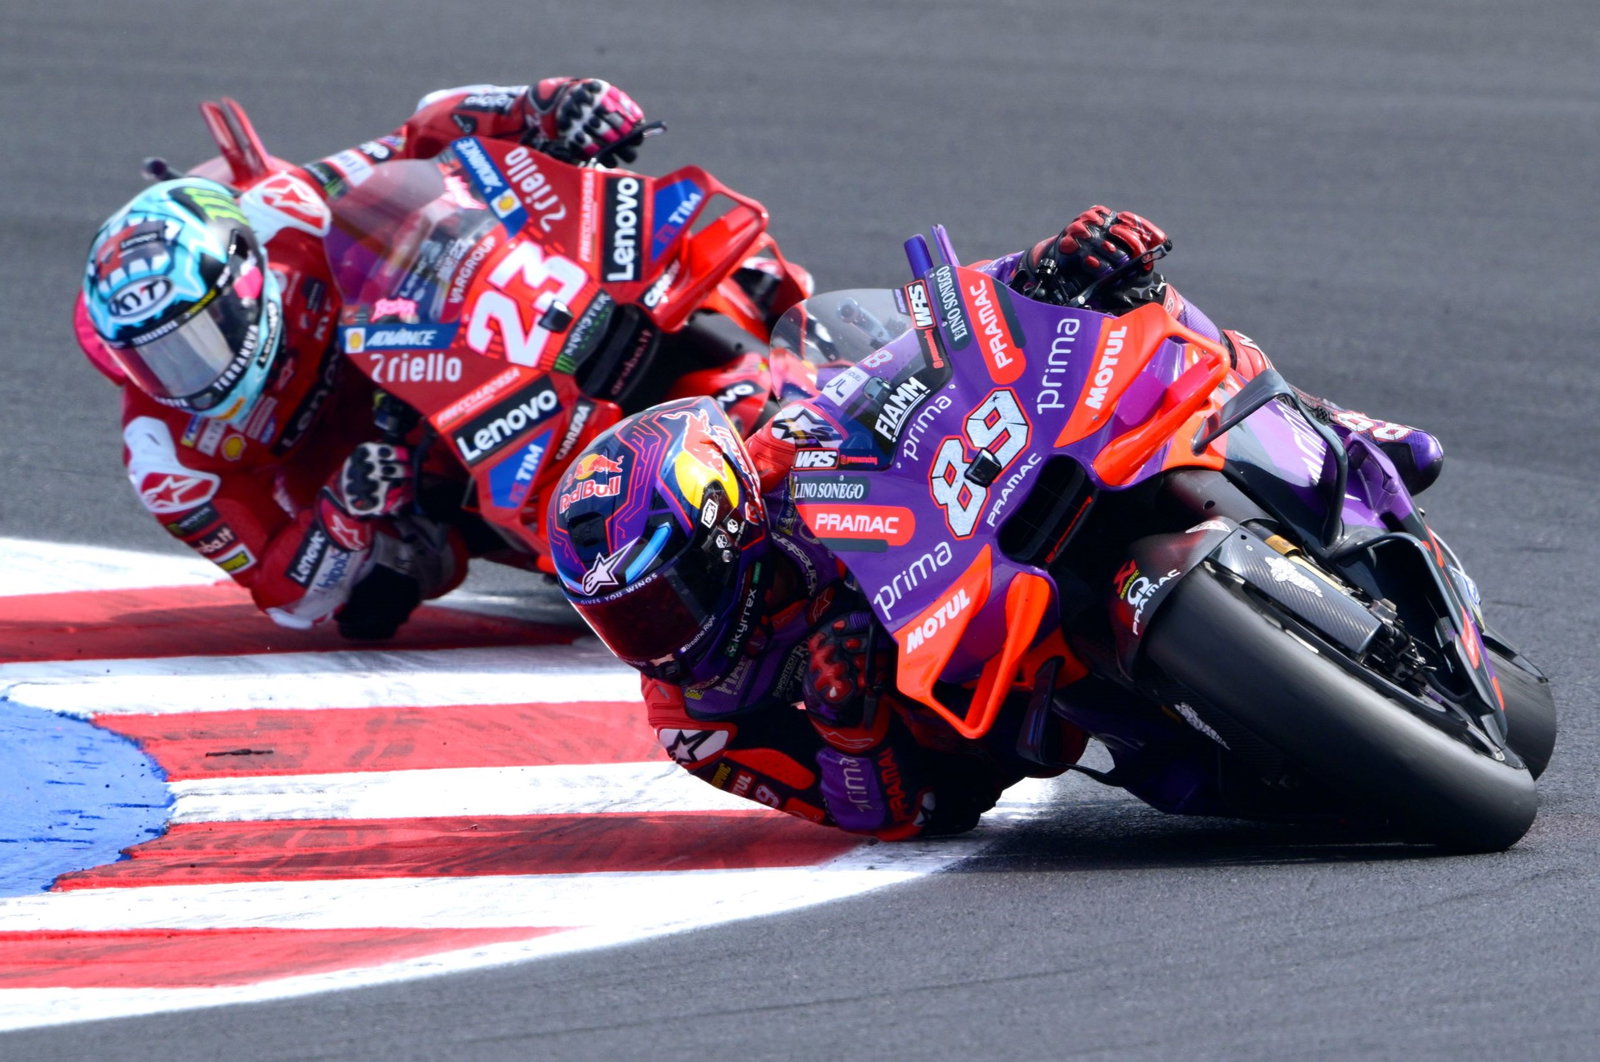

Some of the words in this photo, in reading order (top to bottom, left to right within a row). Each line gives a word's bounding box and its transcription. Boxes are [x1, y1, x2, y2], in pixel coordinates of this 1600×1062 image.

[607, 177, 640, 282] Lenovo
[668, 192, 702, 226] TIM
[111, 278, 163, 314] KYT
[466, 240, 589, 368] 23
[908, 284, 934, 327] WRS
[936, 265, 959, 308] SONEGO
[366, 328, 437, 347] ADVANCE
[564, 291, 612, 356] MONSTER
[969, 278, 1015, 370] PRAMAC
[213, 325, 258, 391] TERRANOVA
[1037, 318, 1081, 414] prima
[1085, 326, 1128, 409] MOTUL
[457, 389, 558, 461] Lenovo
[555, 405, 591, 460] CARRERA
[874, 376, 928, 439] FIAMM
[904, 395, 953, 461] prima
[515, 444, 544, 481] TIM
[794, 482, 817, 499] LINO
[817, 482, 865, 499] SONEGO
[795, 451, 838, 468] WRS
[931, 388, 1030, 538] 89
[986, 453, 1042, 527] PRAMAC
[559, 481, 582, 514] Red
[581, 475, 622, 498] Bull
[815, 513, 899, 534] PRAMAC
[604, 591, 622, 602] YOU
[626, 572, 658, 595] WINGS
[874, 541, 953, 620] prima
[1133, 568, 1181, 635] PRAMAC
[683, 629, 707, 651] Breathe
[733, 589, 757, 642] kyrrex
[907, 588, 971, 655] MOTUL
